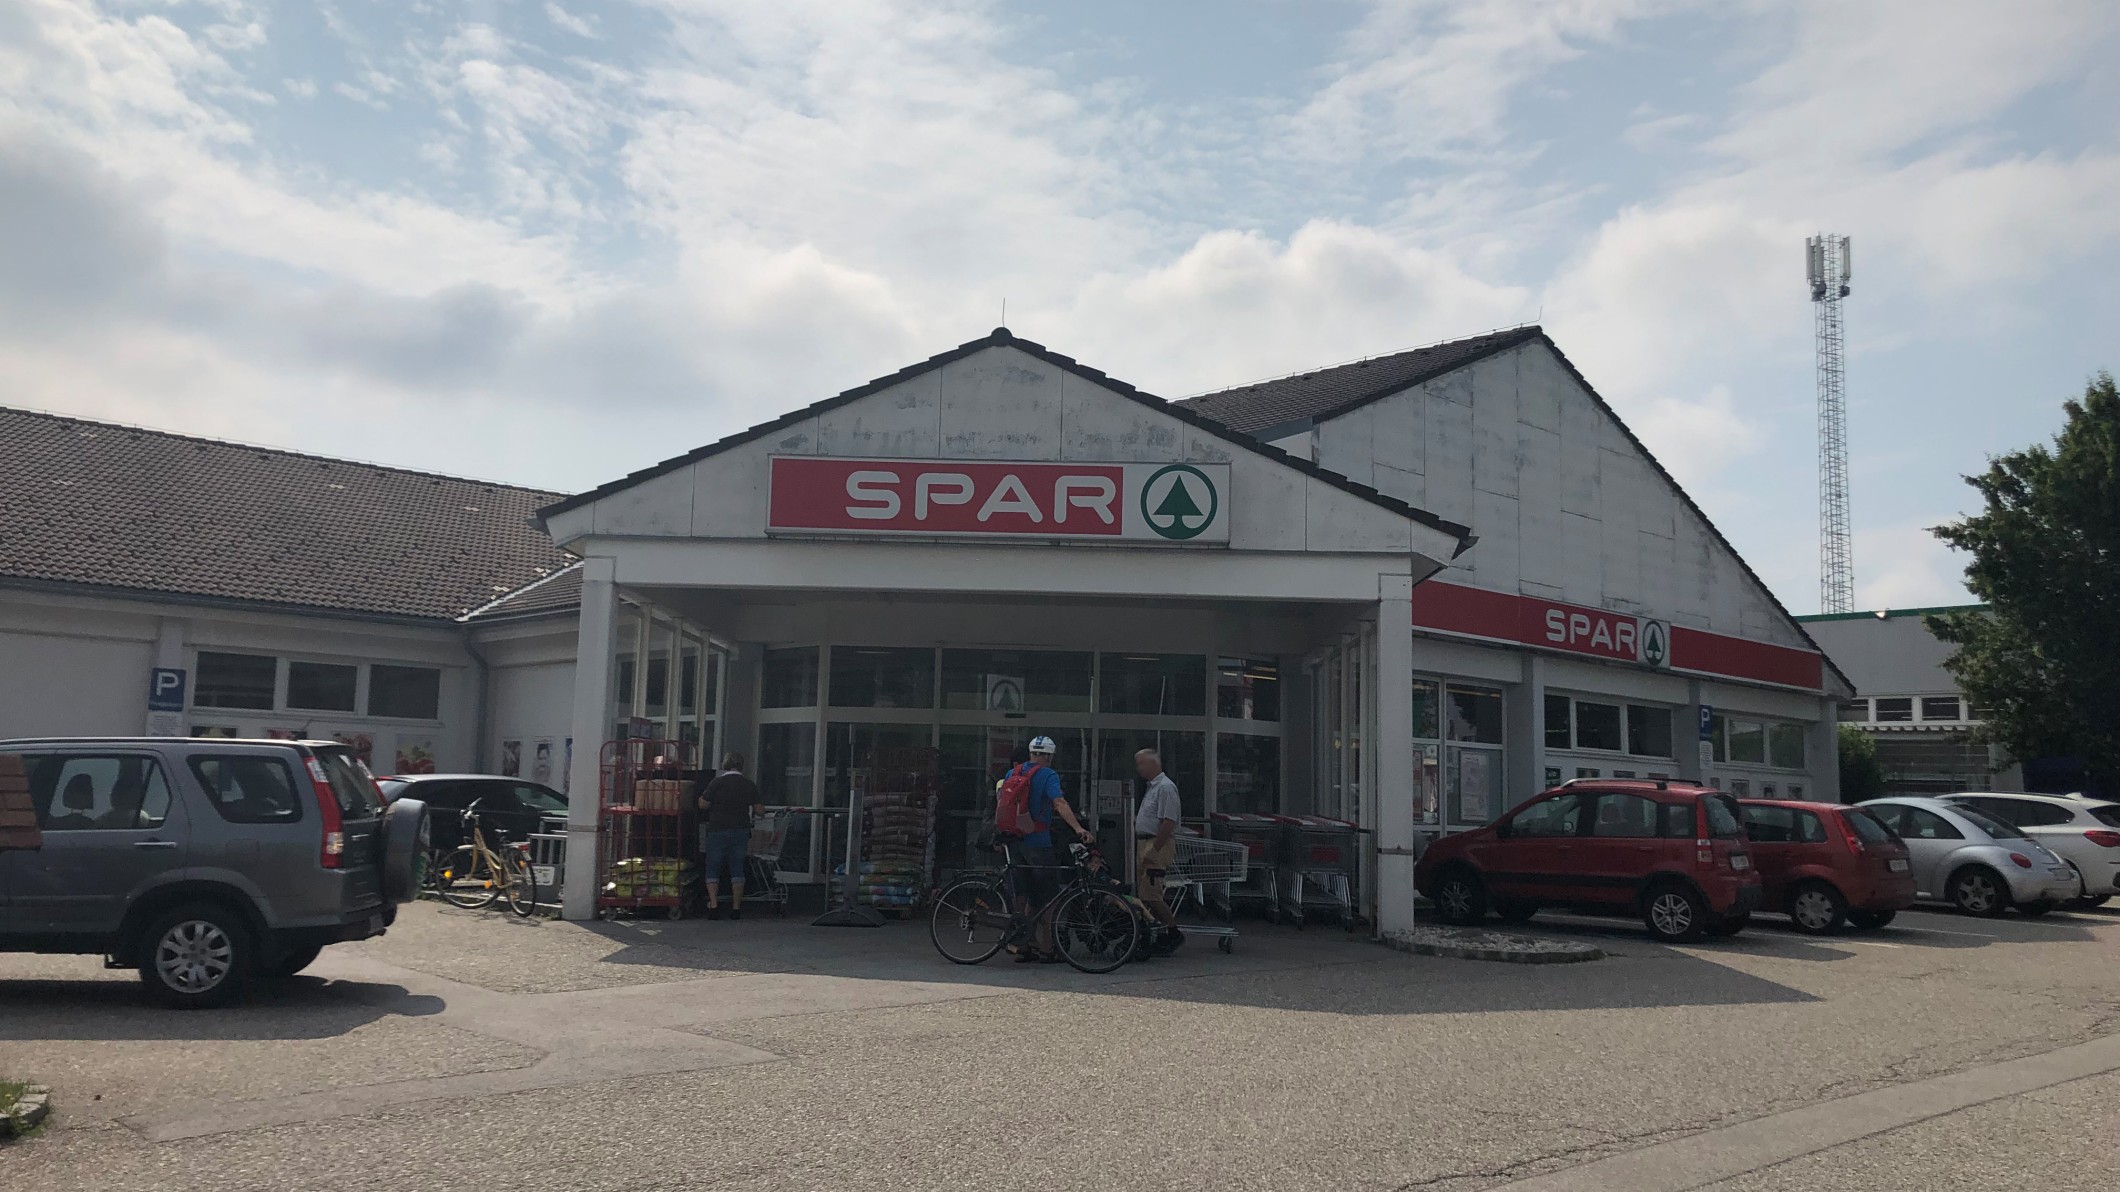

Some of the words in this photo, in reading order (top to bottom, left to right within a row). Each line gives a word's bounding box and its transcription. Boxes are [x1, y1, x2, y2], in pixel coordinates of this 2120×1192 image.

[845, 470, 1116, 525] SPAR
[1545, 609, 1636, 655] SPAR
[156, 671, 179, 696] P
[1701, 708, 1710, 728] P
